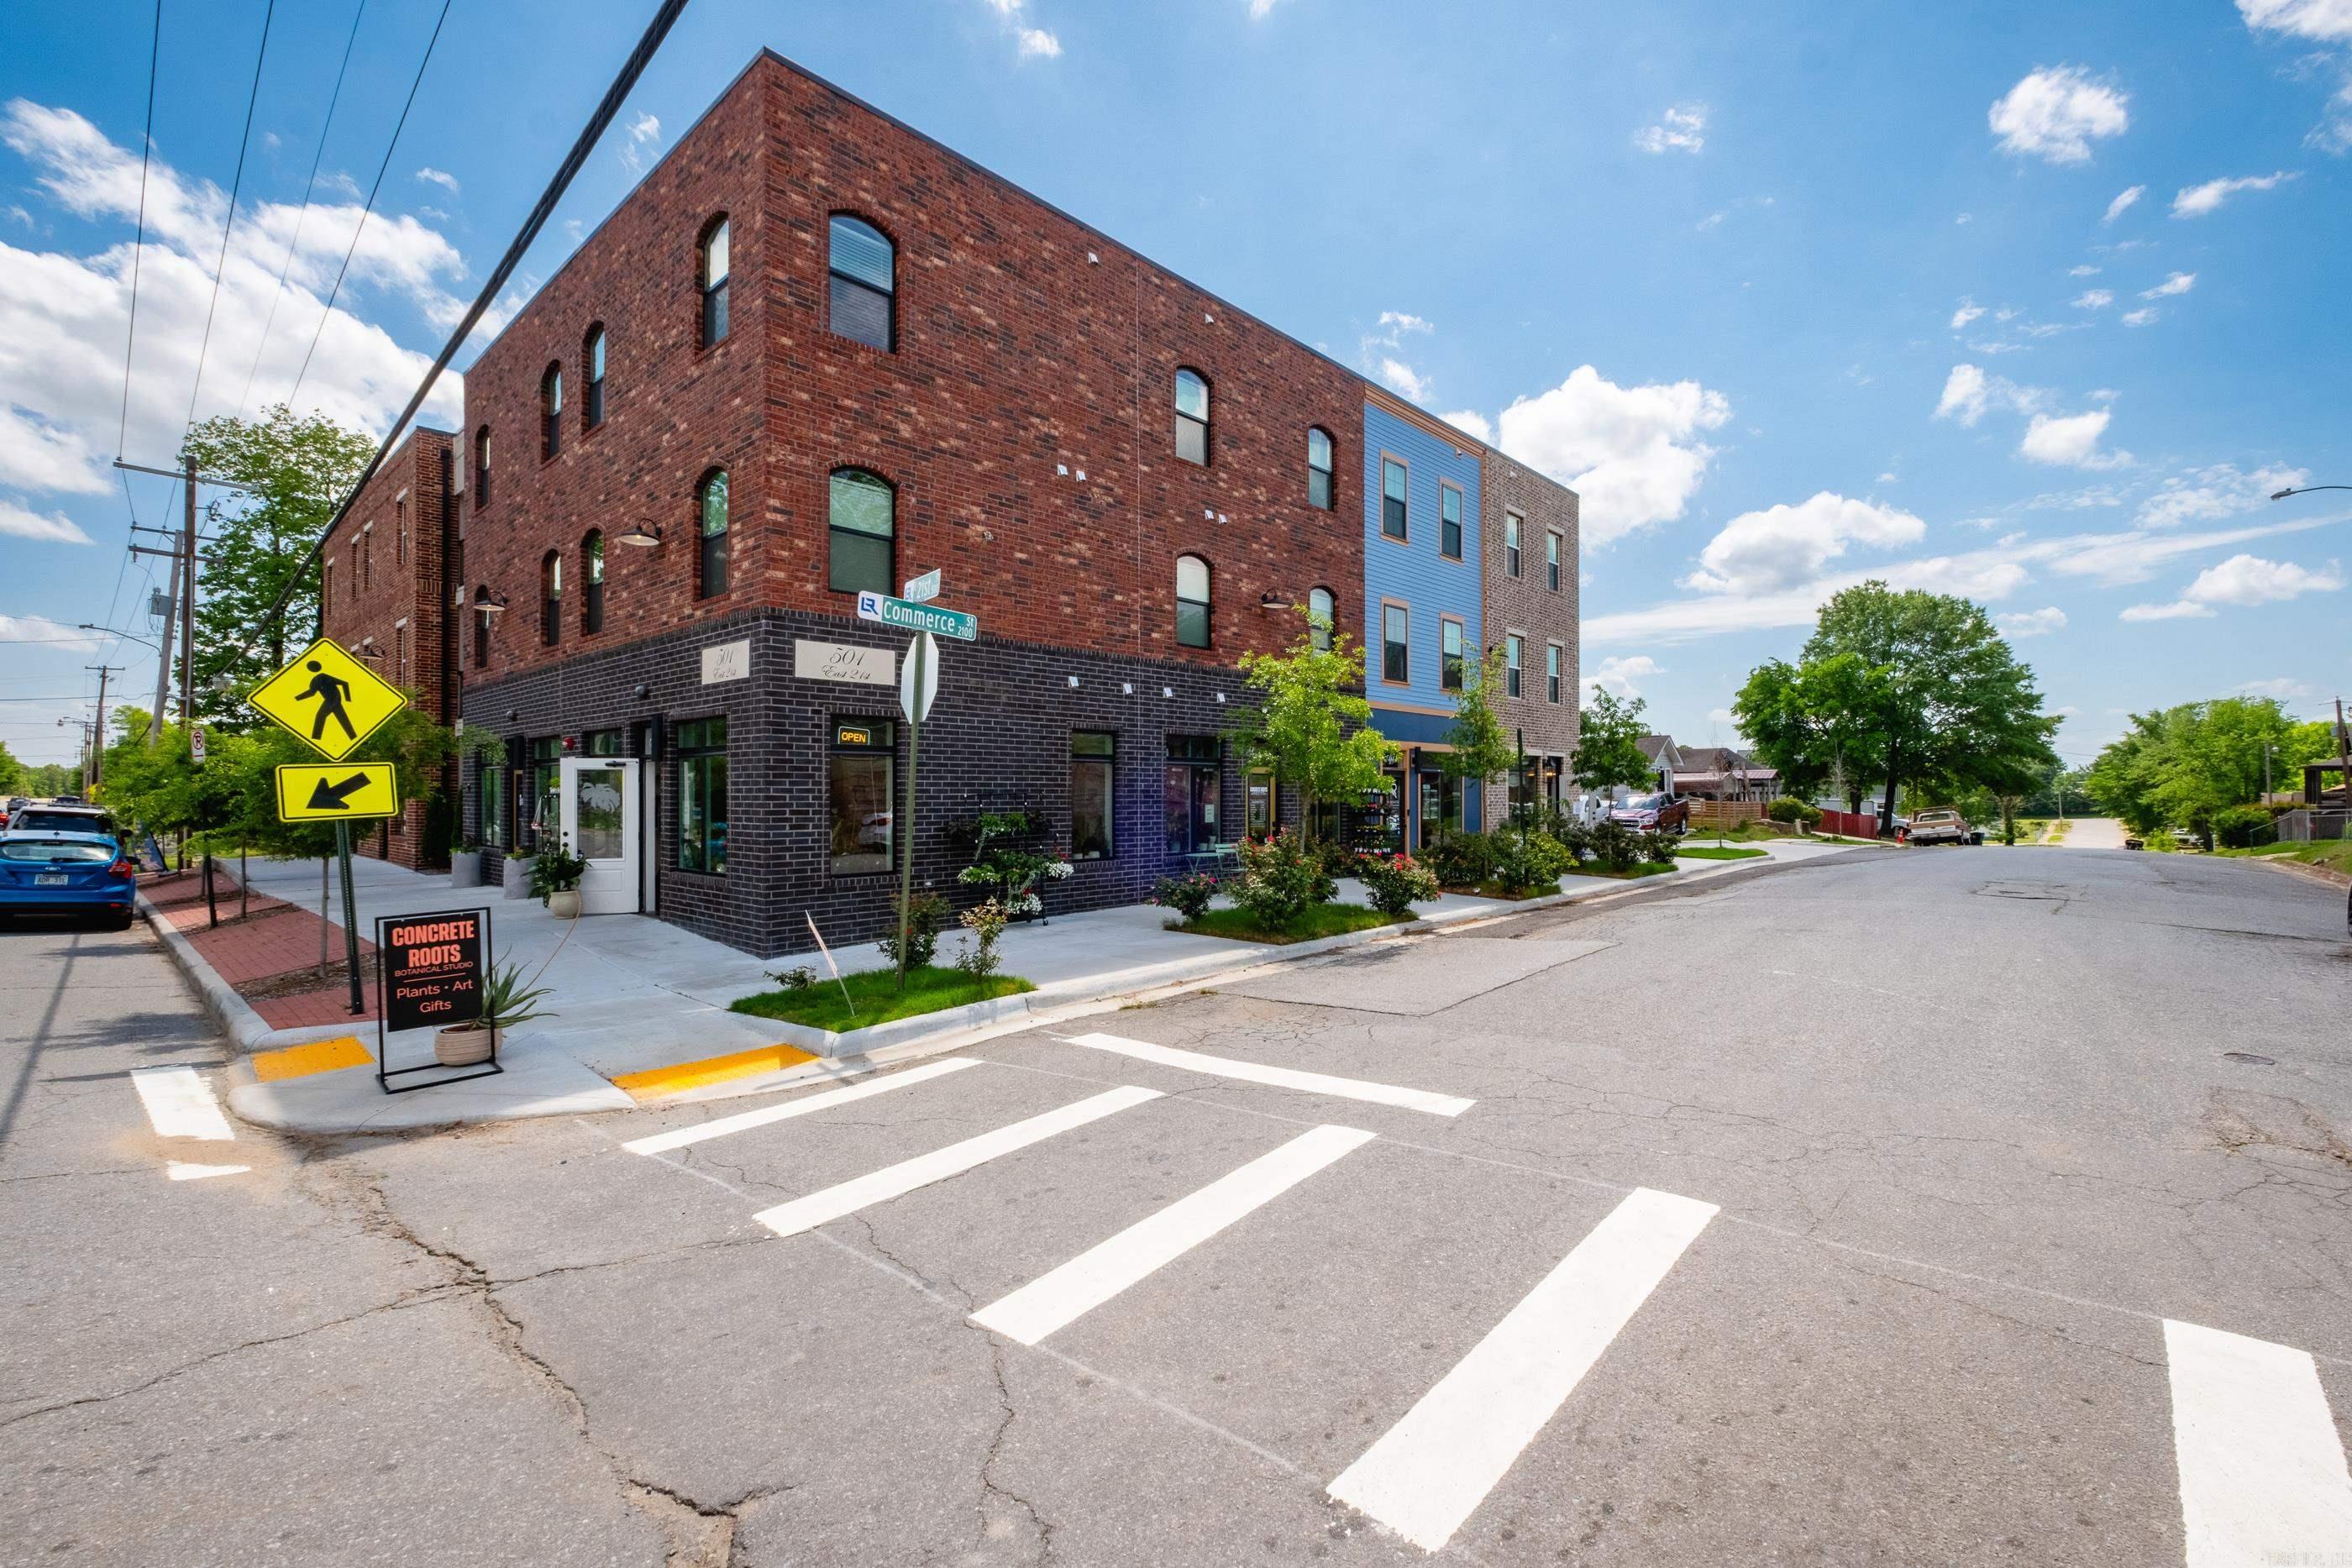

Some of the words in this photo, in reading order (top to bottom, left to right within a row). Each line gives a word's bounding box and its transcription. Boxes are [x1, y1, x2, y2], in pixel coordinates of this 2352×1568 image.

[916, 577, 932, 599] 21st
[883, 600, 955, 632] Commerce
[966, 616, 974, 627] St
[957, 626, 973, 638] 2100
[717, 647, 735, 666] 501
[830, 648, 866, 666] 501
[822, 664, 848, 679] East
[849, 669, 871, 679] 21st
[841, 732, 867, 743] OPEN
[391, 920, 475, 947] CONCRETE
[408, 944, 461, 968] ROOTS
[395, 965, 442, 978] BOTANICAL
[443, 961, 474, 971] STUDIO
[396, 984, 441, 999] Plants
[452, 978, 475, 992] Art
[419, 999, 452, 1013] Gifts
